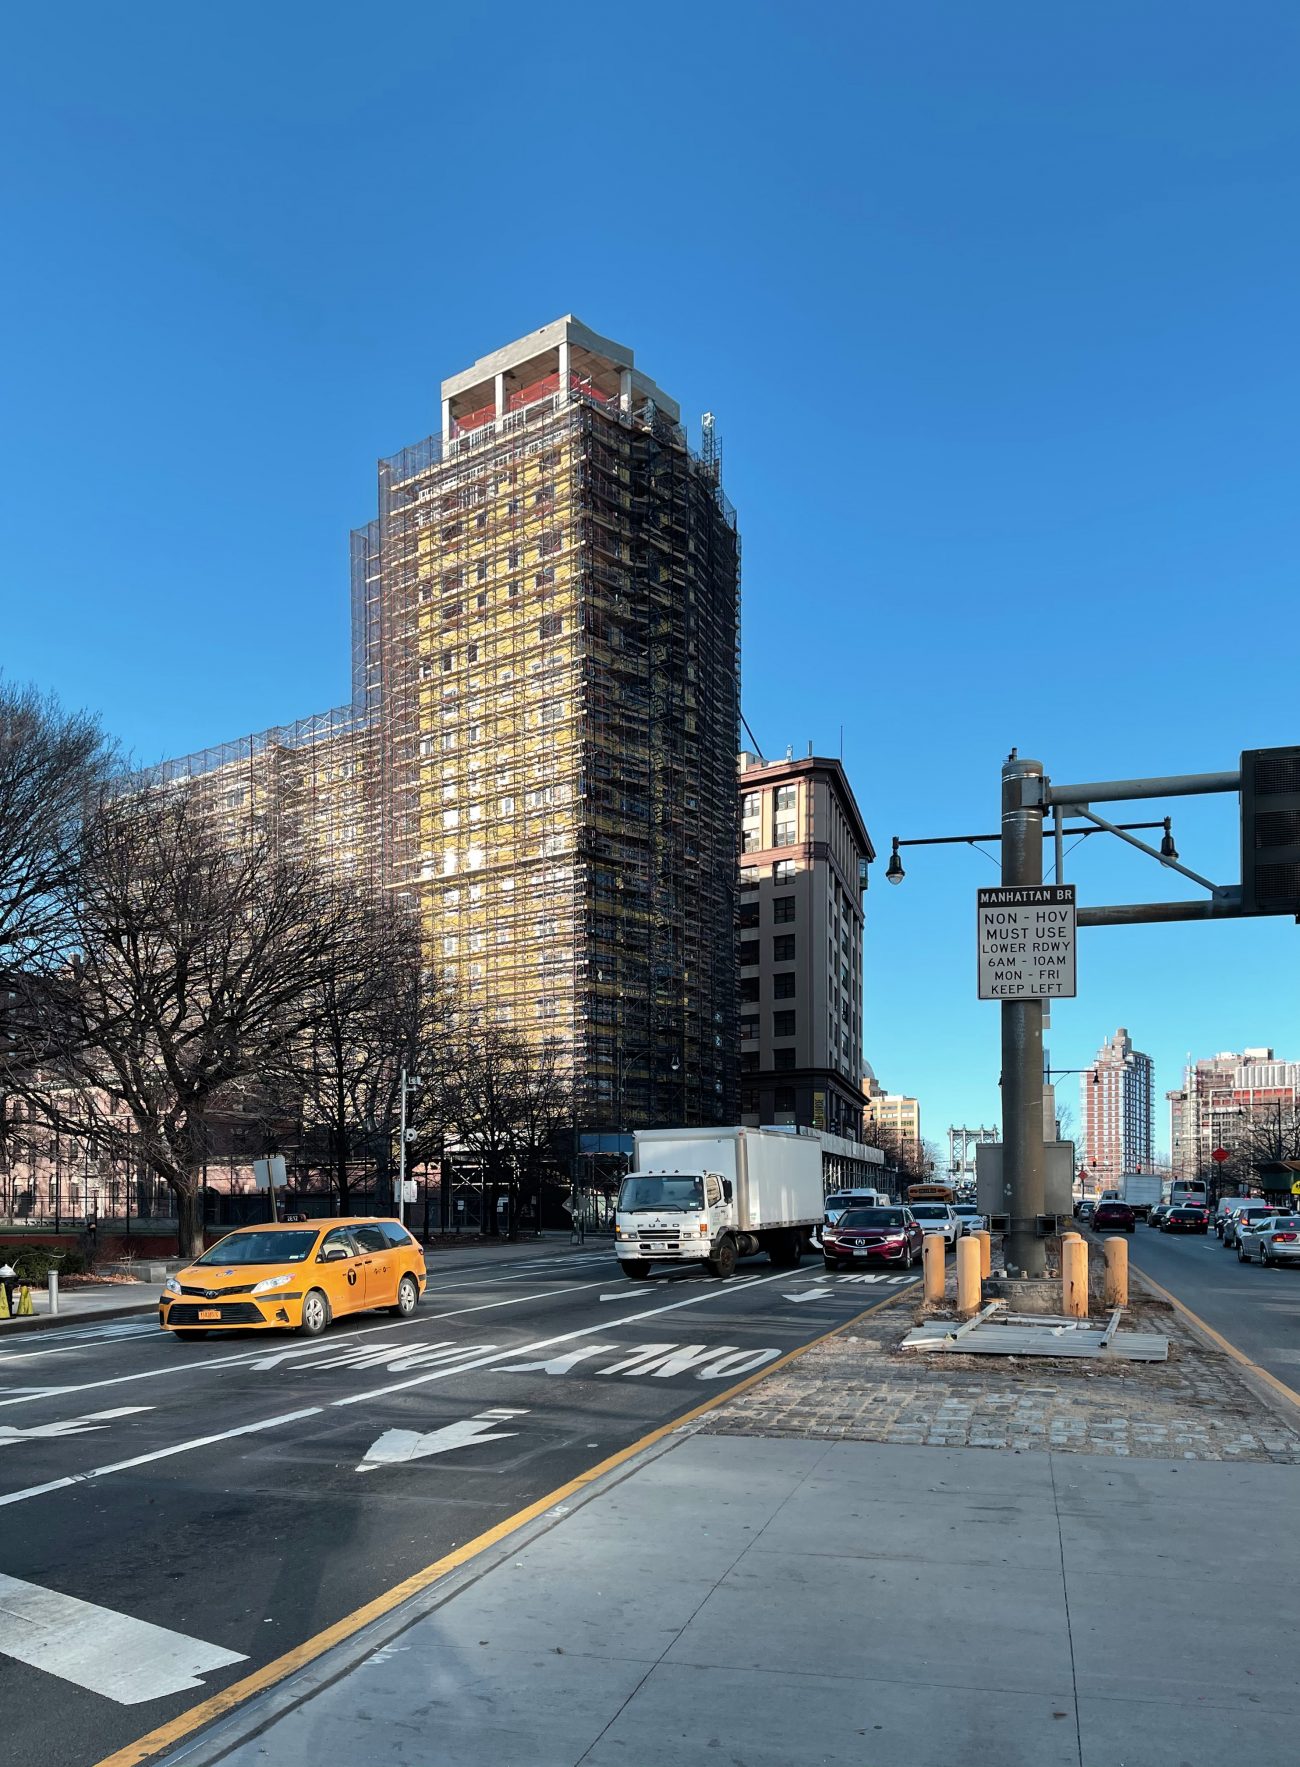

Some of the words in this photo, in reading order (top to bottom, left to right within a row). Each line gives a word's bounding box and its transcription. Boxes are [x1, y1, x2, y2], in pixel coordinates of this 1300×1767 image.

[980, 890, 1051, 903] MANHATTAN
[1056, 889, 1073, 900] BR
[984, 912, 1017, 925] NON
[1036, 911, 1068, 923] HOV
[986, 927, 1029, 940] MUST
[1036, 926, 1067, 938] USE
[982, 943, 1026, 954] LOWER
[1032, 941, 1071, 952] RDWY
[988, 957, 1016, 967] 6AM
[1033, 955, 1066, 966] 10AM
[994, 970, 1022, 980] MON
[1040, 969, 1059, 979] FRI
[991, 984, 1025, 994] KEEP
[1031, 983, 1063, 994] LEFT
[790, 1275, 921, 1285] ONLY
[200, 1341, 498, 1371] ONLY
[489, 1344, 783, 1380] ONLY
